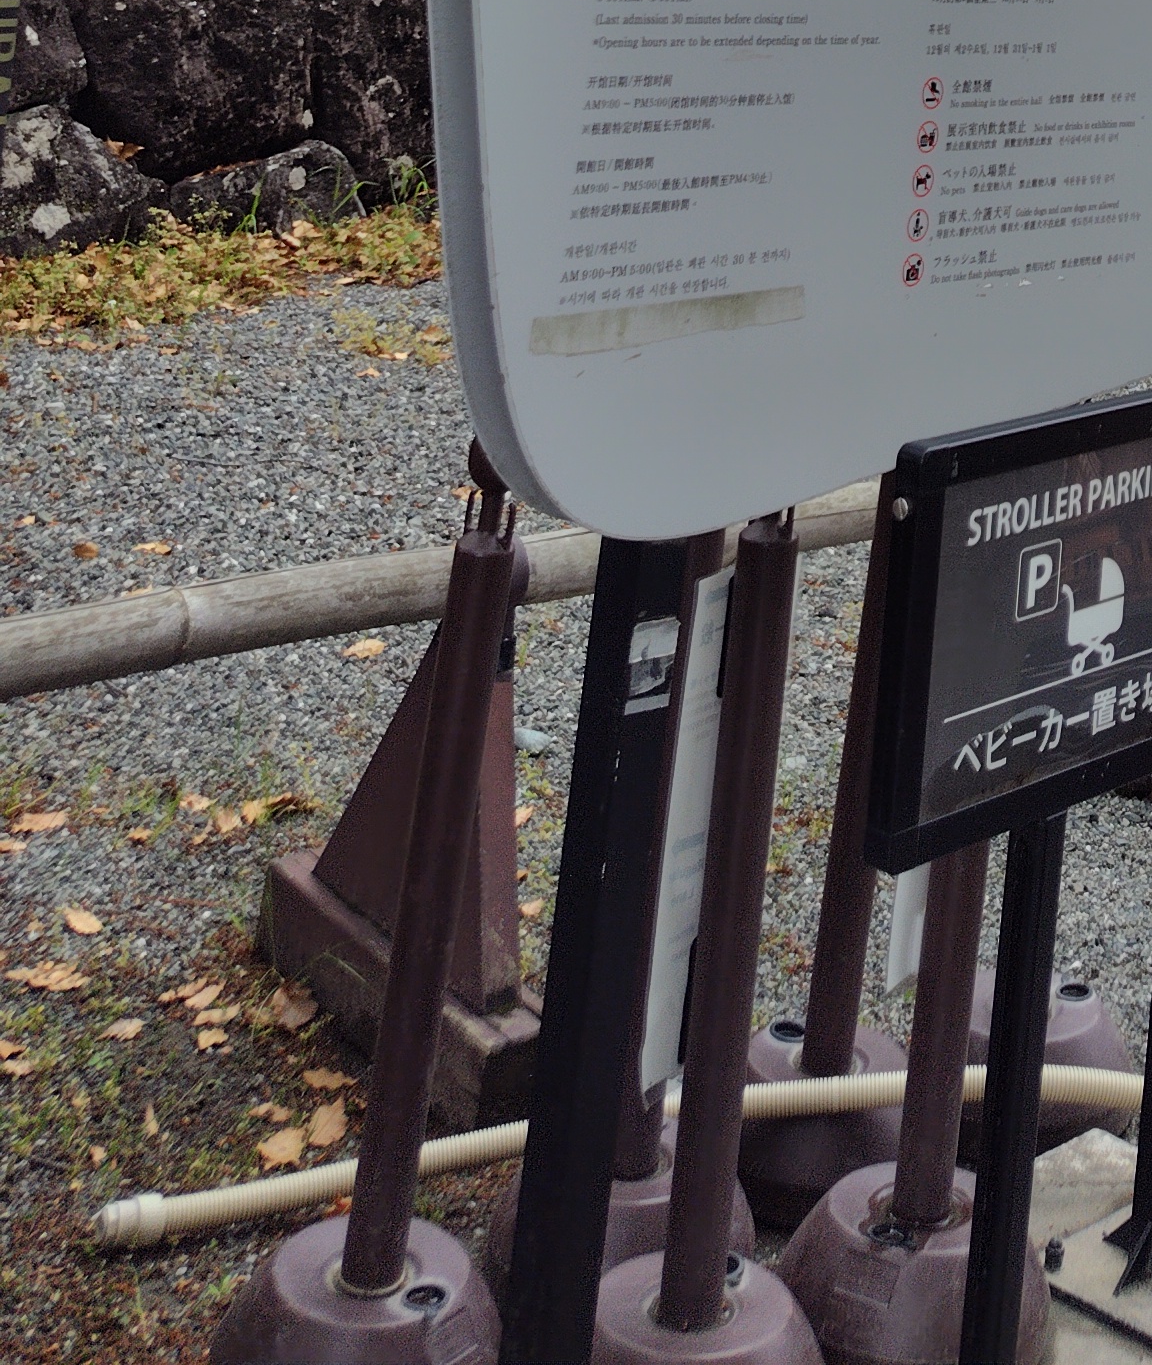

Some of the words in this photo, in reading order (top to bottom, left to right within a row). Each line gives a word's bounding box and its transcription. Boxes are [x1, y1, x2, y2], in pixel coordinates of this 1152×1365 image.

[623, 14, 668, 25] admission
[671, 13, 683, 24] 30
[685, 15, 721, 24] minutes
[724, 13, 751, 24] before
[754, 14, 784, 25] closing
[641, 36, 667, 47] hours
[671, 38, 685, 47] are
[688, 37, 697, 46] to
[700, 36, 711, 46] be
[714, 35, 753, 46] extended
[756, 35, 799, 47] depending
[802, 37, 811, 45] on
[815, 35, 827, 45] the
[830, 36, 848, 45] time
[851, 34, 859, 45] of
[952, 79, 992, 94] 全館禁煙
[950, 99, 959, 108] No
[961, 99, 988, 108] smoking
[990, 98, 996, 107] in
[998, 97, 1008, 106] the
[1010, 97, 1029, 107] entire
[1044, 123, 1056, 132] food
[1065, 122, 1083, 131] drinks
[942, 163, 1016, 179] ペットの入場禁止
[940, 186, 950, 196] No
[951, 187, 966, 196] pets
[1016, 207, 1032, 217] Guide
[1034, 207, 1047, 217] dogs
[1048, 205, 1059, 215] and
[1074, 204, 1087, 213] dogs
[934, 249, 997, 267] フラッシュ禁止
[930, 275, 940, 284] Do
[941, 274, 951, 283] not
[953, 272, 967, 282] take
[968, 271, 982, 280] flash
[984, 267, 1020, 279] photographs
[967, 483, 1082, 547] STROLLER
[1026, 554, 1053, 609] P
